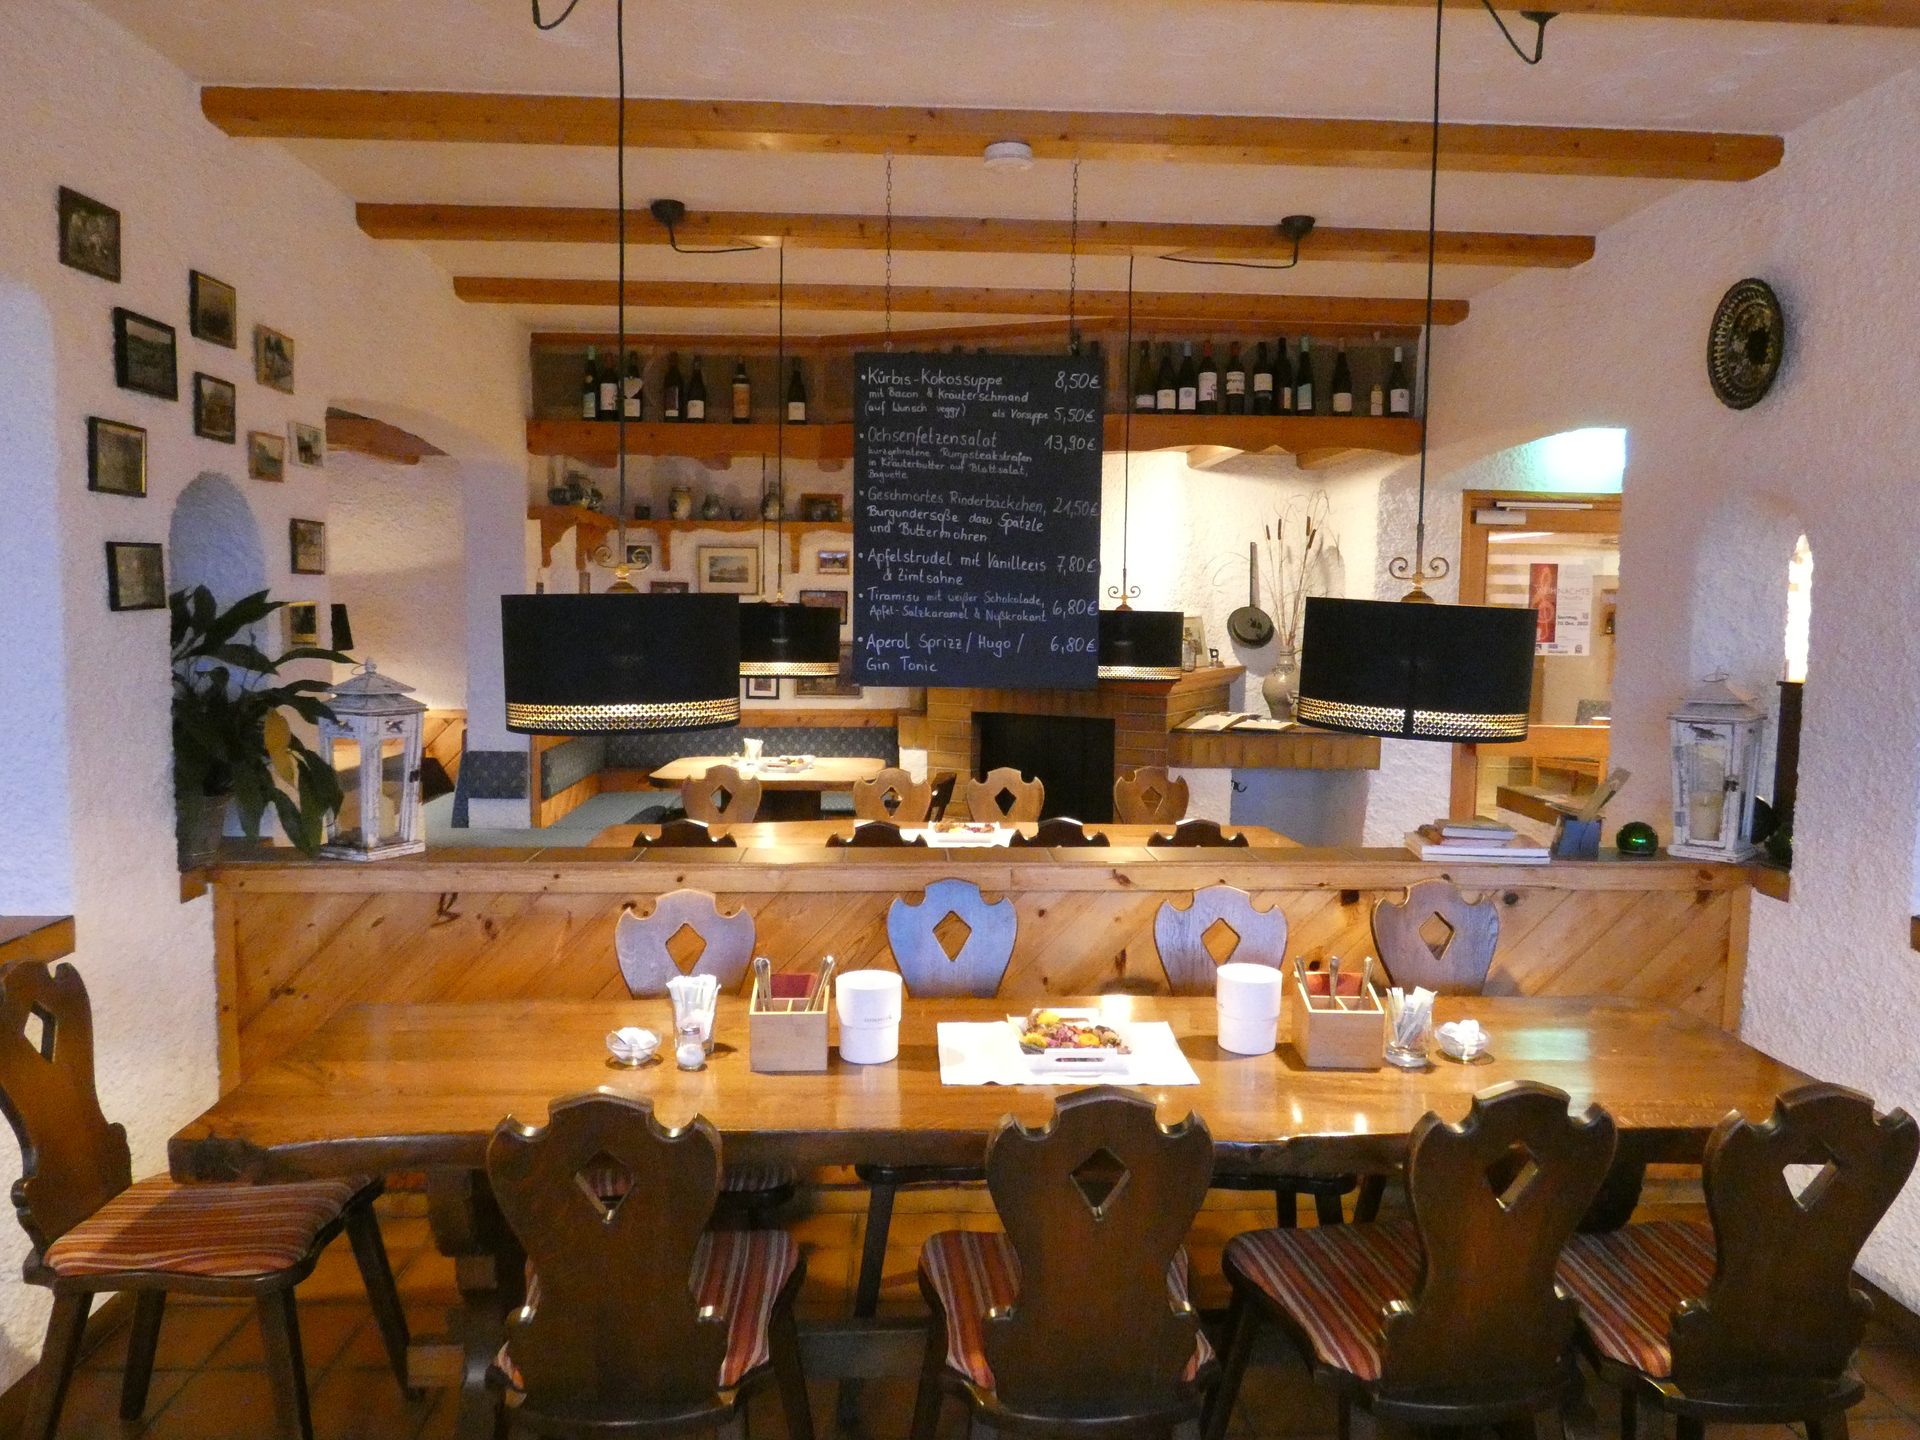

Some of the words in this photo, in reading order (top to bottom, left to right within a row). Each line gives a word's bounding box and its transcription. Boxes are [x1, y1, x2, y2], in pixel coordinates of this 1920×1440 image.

[1055, 370, 1101, 393] 8,50€
[869, 388, 884, 399] mit
[888, 386, 919, 399] Bacon
[865, 400, 886, 417] (auf
[892, 401, 928, 413] Wunsch
[936, 402, 967, 418] veggy)
[992, 409, 1006, 418] als
[1010, 408, 1049, 425] Vorsuppe
[1054, 406, 1096, 424] 5,50€
[867, 426, 998, 448] Ochsenfetzensalat
[1044, 434, 1097, 455] 13,90€
[867, 486, 944, 504] Geschmortes
[1052, 496, 1100, 520] 21,50€
[869, 520, 892, 534] und
[969, 512, 993, 525] dazu
[867, 548, 953, 569] Apfelstrudel
[960, 552, 982, 567] mit
[987, 552, 1047, 572] Vanilleeis
[1057, 555, 1097, 576] 7,80€
[867, 586, 920, 602] Tiramisu
[926, 589, 942, 601] mit
[1052, 599, 1098, 619] 6,80€
[866, 632, 911, 655] Aperol
[978, 634, 1011, 658] Hugo
[1050, 636, 1097, 655] 6,80€
[866, 657, 890, 671] Gin
[899, 656, 938, 672] Tonic
